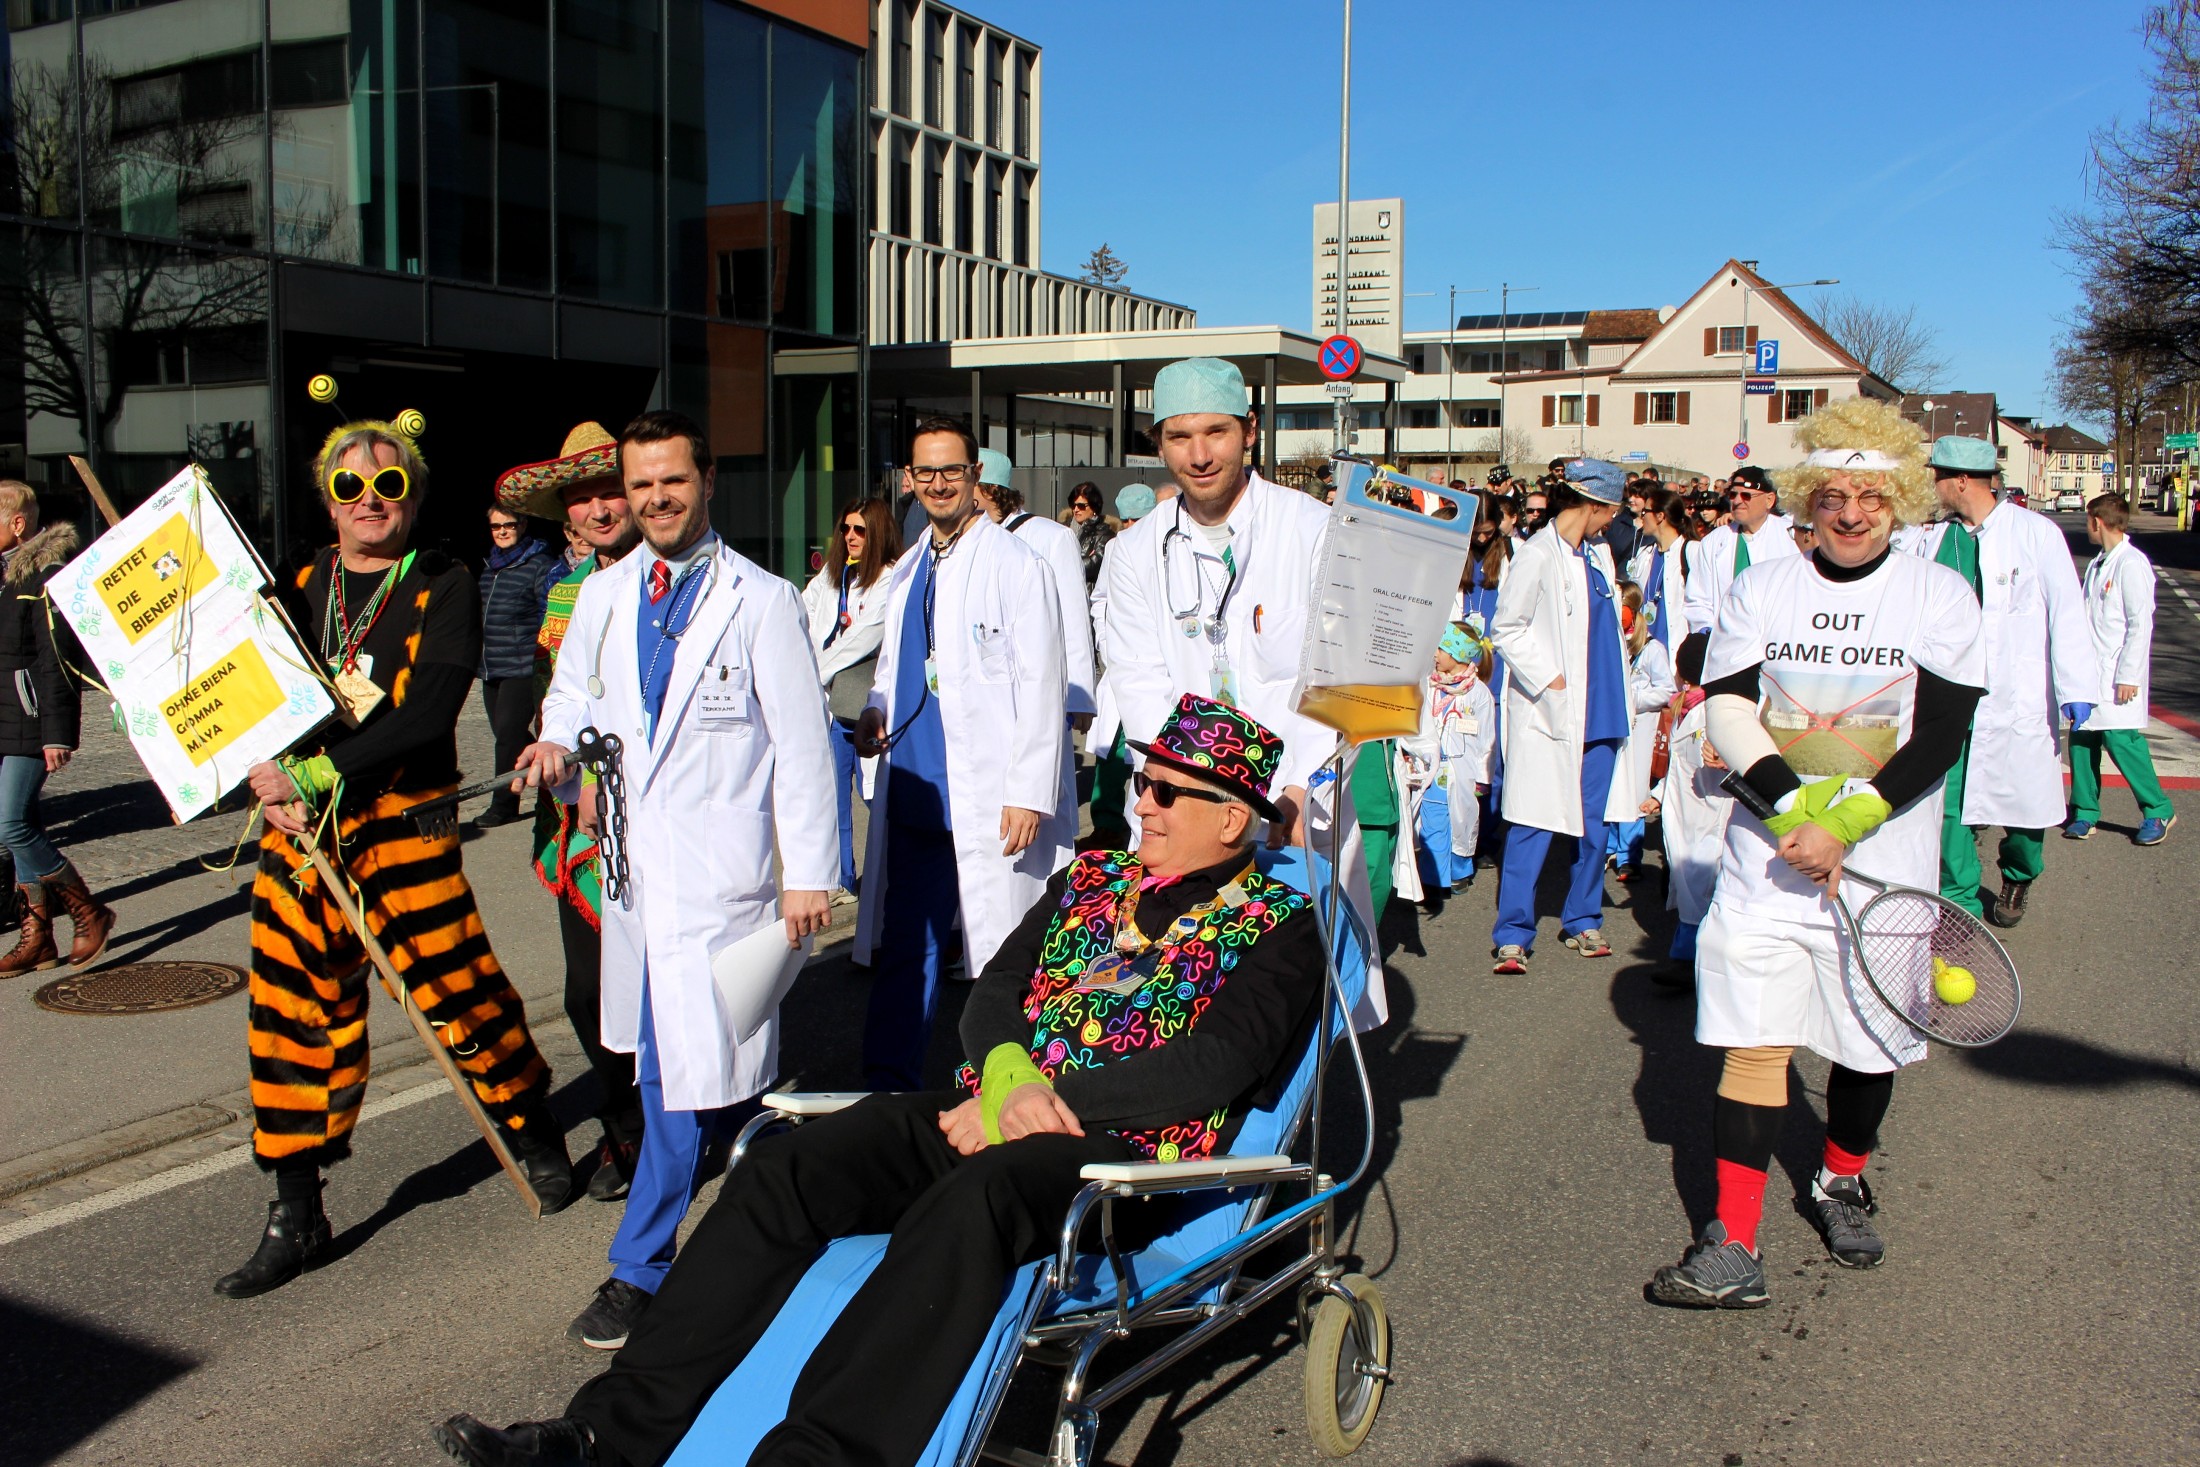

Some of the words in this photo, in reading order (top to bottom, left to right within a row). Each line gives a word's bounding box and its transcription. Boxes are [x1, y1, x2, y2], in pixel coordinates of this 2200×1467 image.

[1326, 235, 1384, 244] GENDEHAUS
[1326, 270, 1385, 279] GEINDEAMT
[1326, 283, 1371, 291] SPKASSE
[1326, 295, 1357, 303] POEI
[1325, 318, 1384, 326] RESANWALT
[1761, 346, 1774, 366] P
[1326, 384, 1351, 395] Anfang
[102, 547, 147, 591] RETTET
[117, 589, 141, 614] DIE
[1372, 587, 1389, 596] ORAL
[1390, 591, 1407, 600] CALF
[1407, 596, 1433, 607] FEEDER
[1811, 612, 1865, 631] OUT
[1765, 642, 1833, 664] GAME
[1840, 646, 1905, 668] OVER
[166, 687, 201, 717] OHNE
[200, 661, 237, 693] BIENA
[176, 698, 223, 734] GOMMA
[186, 724, 223, 753] MAYA
